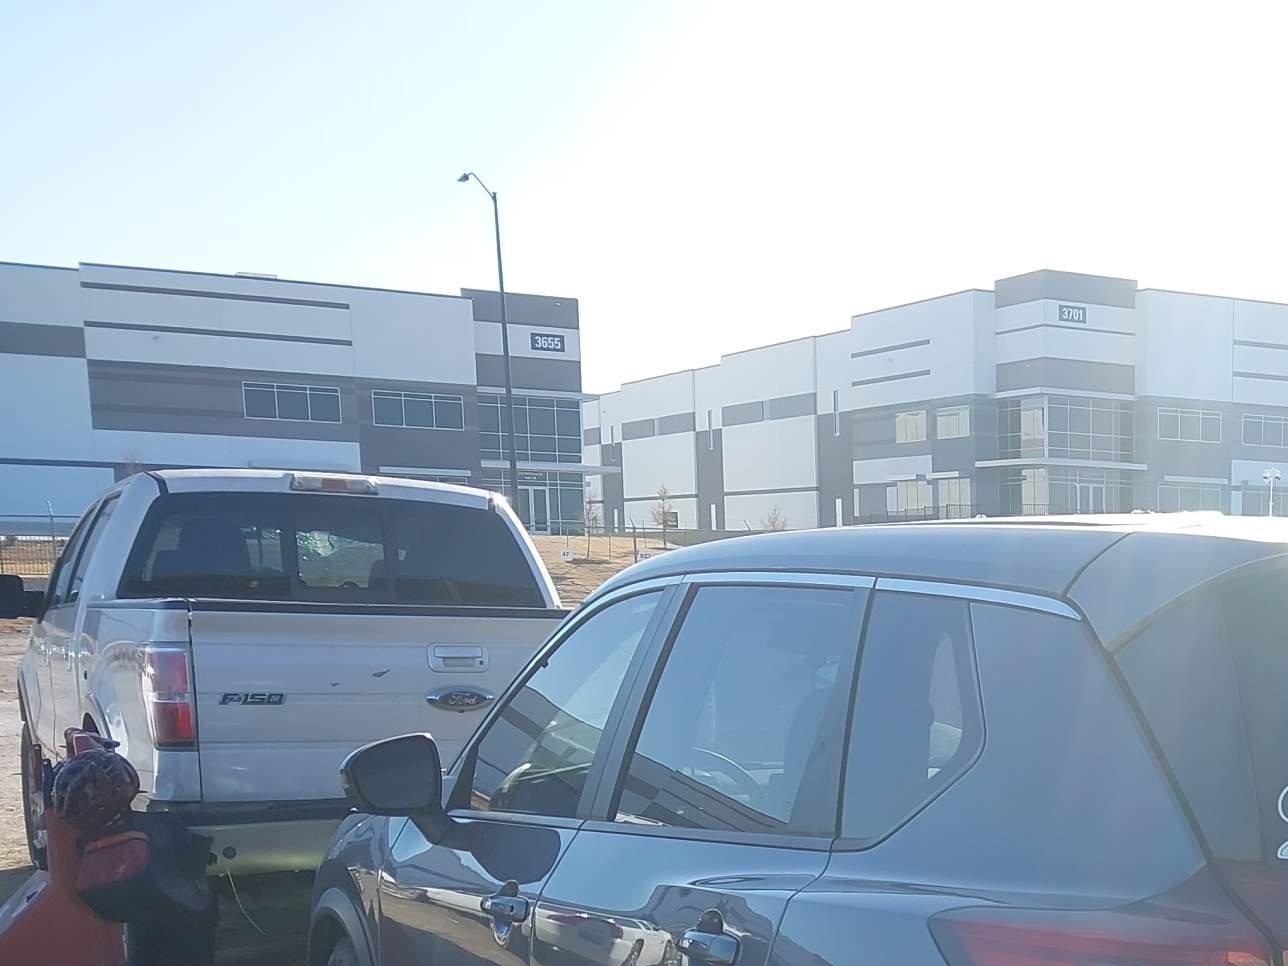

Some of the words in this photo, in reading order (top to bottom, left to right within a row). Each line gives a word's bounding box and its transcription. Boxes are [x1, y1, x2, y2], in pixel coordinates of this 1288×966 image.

[1062, 307, 1083, 321] 3701
[534, 336, 561, 349] 3655
[219, 693, 286, 705] F-150
[448, 692, 480, 705] Ford
